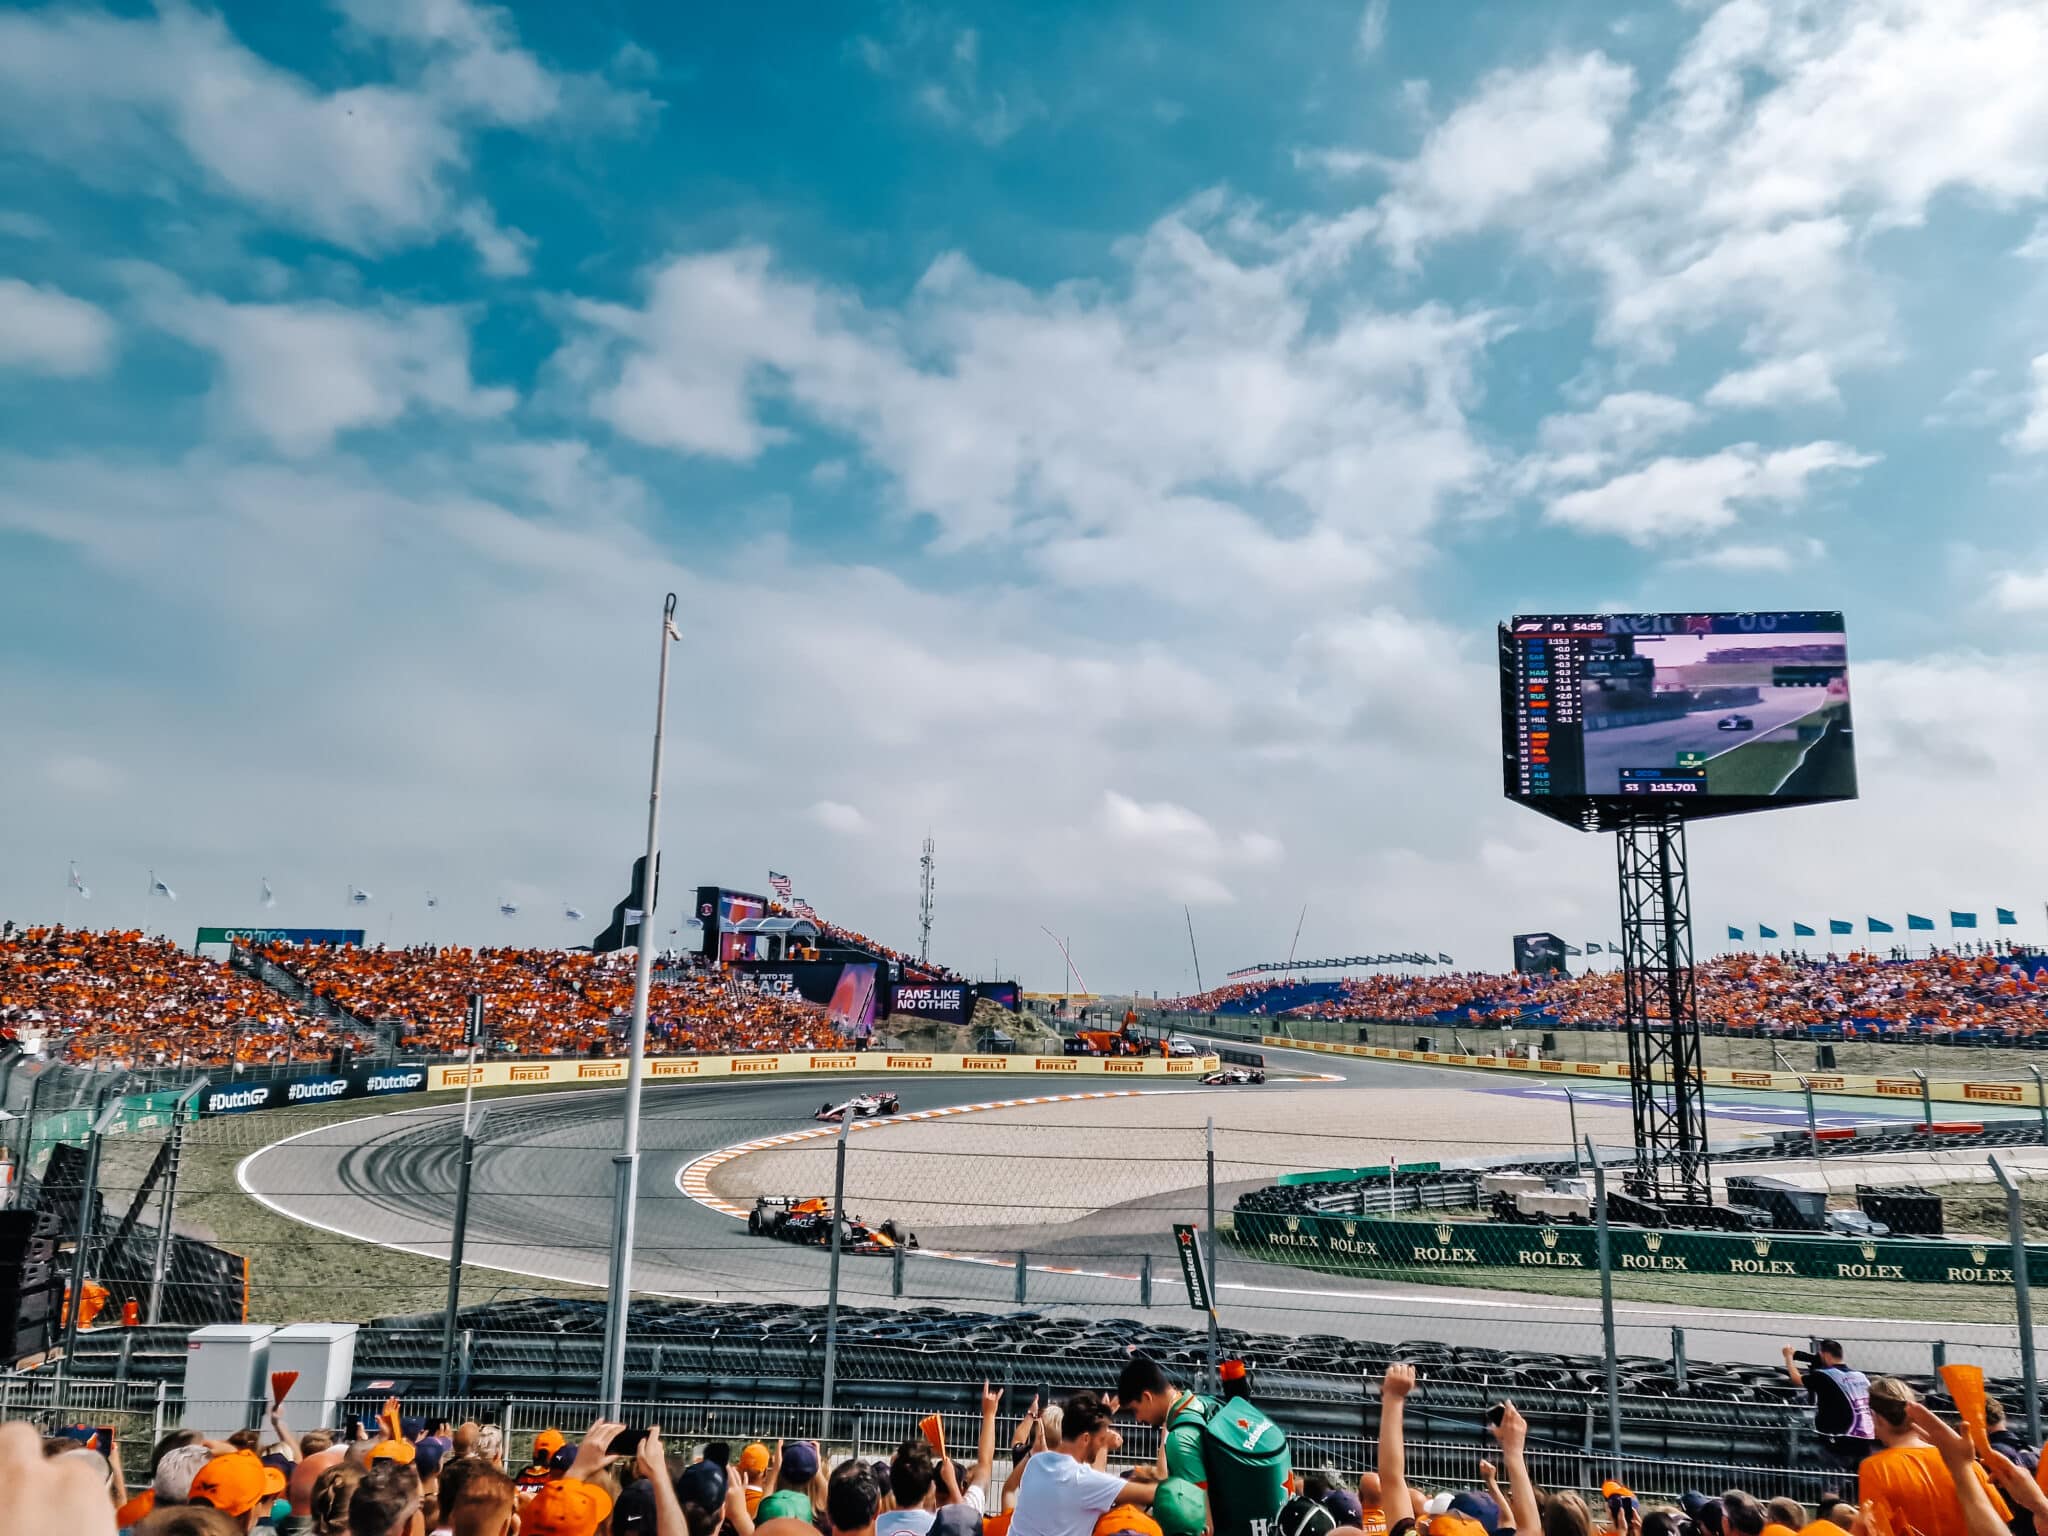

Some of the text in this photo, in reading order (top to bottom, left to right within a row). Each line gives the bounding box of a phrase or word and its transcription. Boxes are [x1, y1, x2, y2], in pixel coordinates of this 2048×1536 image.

[1552, 623, 1567, 631] P1
[1650, 784, 1698, 792] 1:15.701
[897, 989, 960, 1000] FANS LIKE
[897, 1000, 960, 1010] NO OTHER
[652, 1061, 699, 1075] PIRELLI
[731, 1058, 778, 1071] PIRELLI
[810, 1056, 856, 1068] PIRELLI
[887, 1056, 932, 1068] PIRELLI
[963, 1058, 1007, 1069] PIRELLI
[1036, 1059, 1077, 1070] PIRELLI
[1104, 1060, 1143, 1072] PIRELLI
[1167, 1061, 1193, 1071] PIRELLI
[442, 1067, 483, 1085] PIRELI
[510, 1065, 549, 1080] PIRELLI
[578, 1063, 621, 1077] PIRELLI
[367, 1074, 422, 1091] #DutchGP
[1732, 1072, 1771, 1086] PIRELLI
[288, 1080, 347, 1100] #DutchGP
[1964, 1084, 2022, 1101] PIRELLI
[209, 1088, 268, 1111] #DutchGP
[1269, 1233, 1318, 1247] ROLEX
[1330, 1237, 1377, 1255] ROLEX
[1414, 1247, 1477, 1262] ROLEX
[1519, 1251, 1583, 1266] ROLEX
[1621, 1254, 1688, 1270] ROLEX
[1730, 1259, 1796, 1275] ROLEX
[1183, 1249, 1203, 1306] Heineken
[1838, 1264, 1904, 1279] ROLEX
[1947, 1267, 2015, 1282] ROLEX
